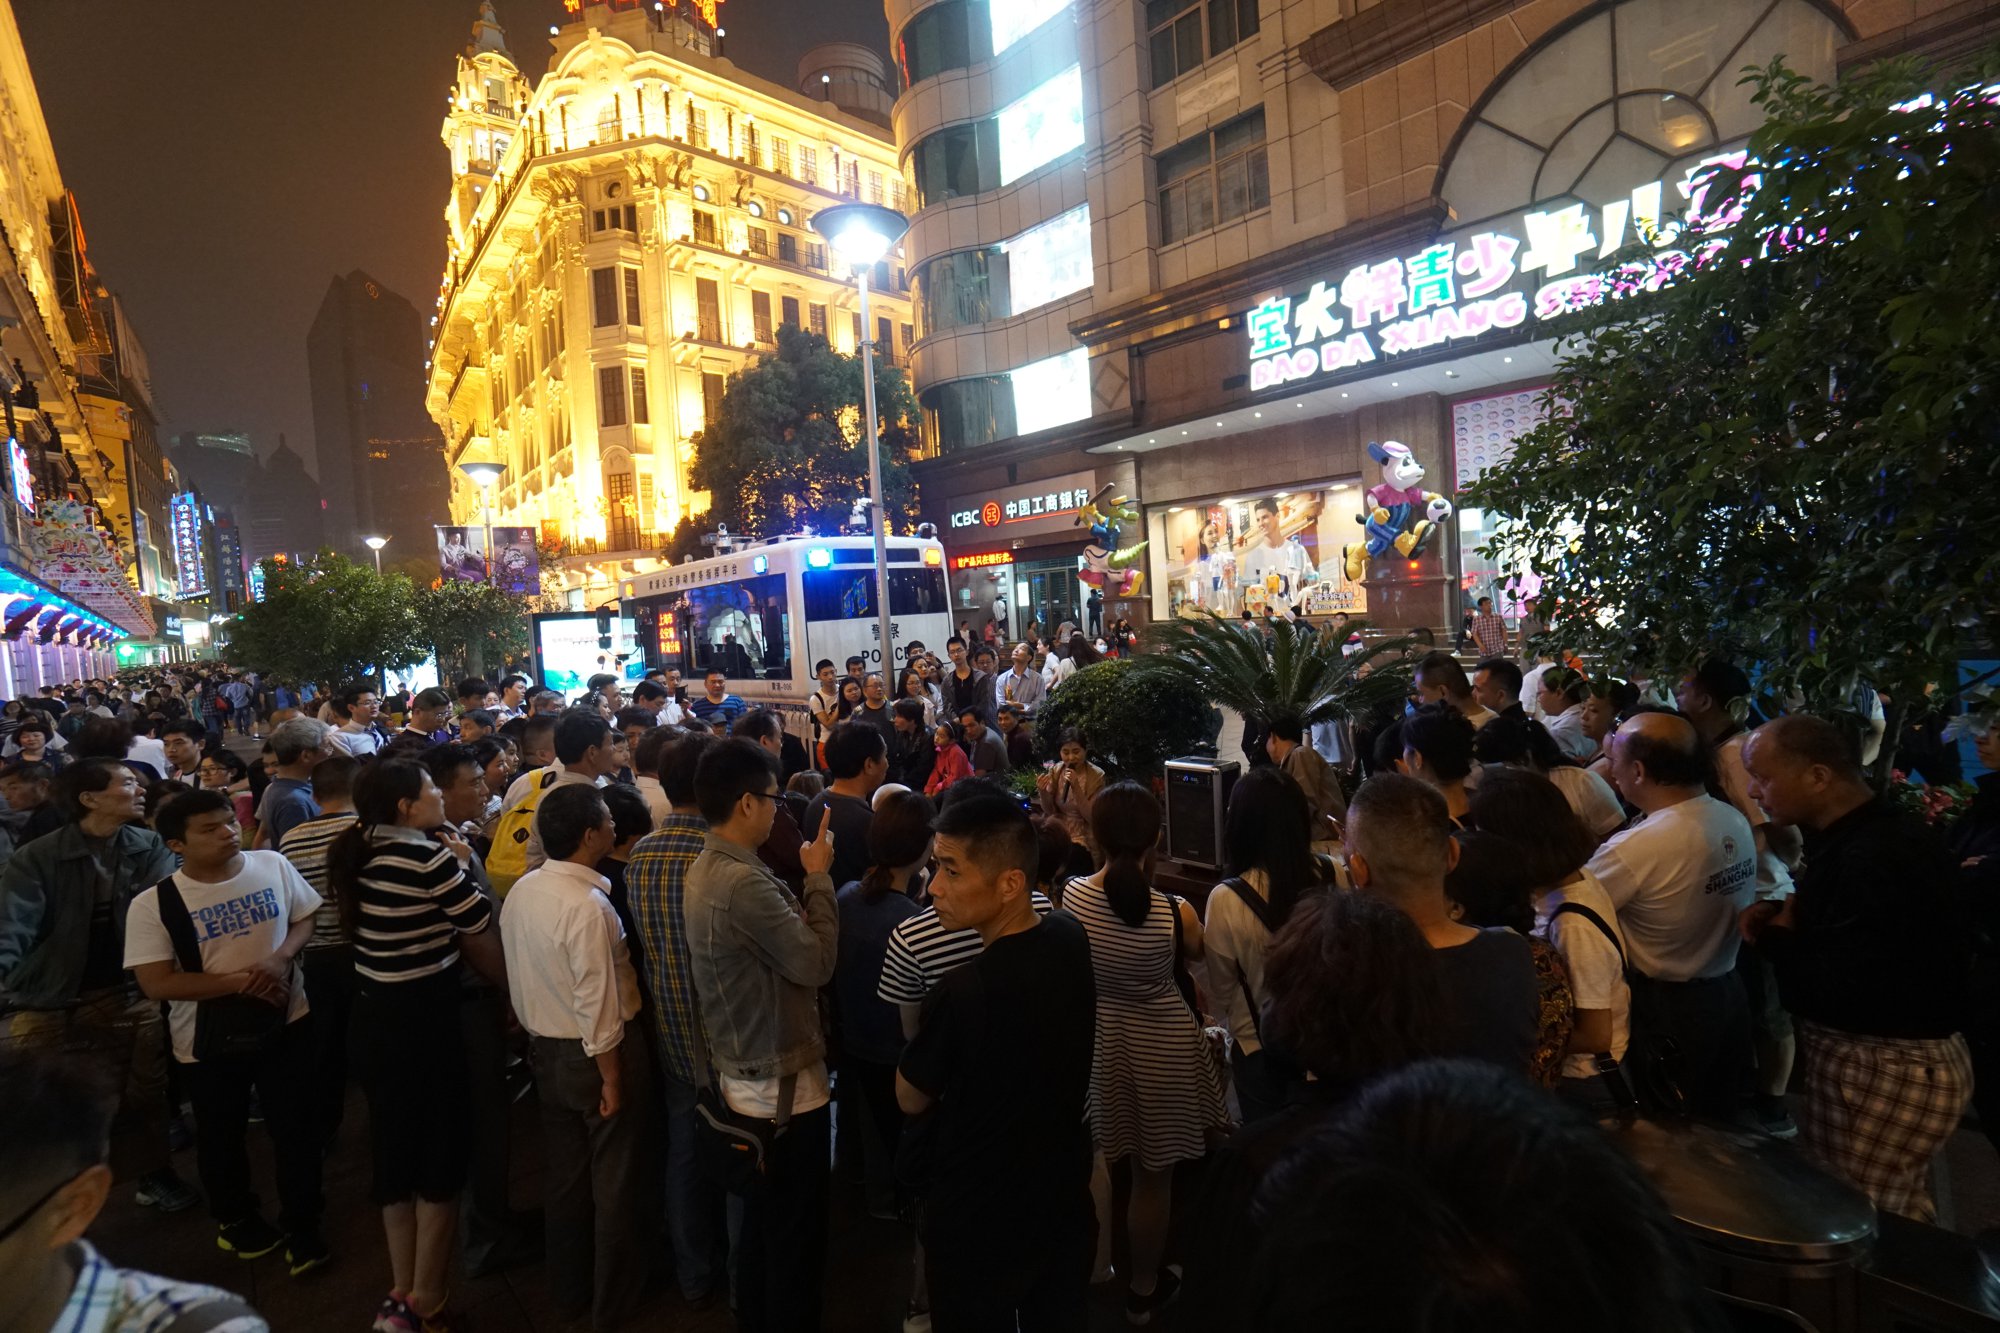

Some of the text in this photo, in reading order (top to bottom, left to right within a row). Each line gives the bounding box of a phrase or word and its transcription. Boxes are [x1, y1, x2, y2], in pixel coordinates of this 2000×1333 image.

[1250, 348, 1318, 391] BAO
[1322, 332, 1376, 372] DA
[1378, 292, 1527, 355] XIANG
[1005, 488, 1089, 518] 中国工商银行
[951, 509, 980, 528] ICBC
[658, 612, 673, 626] 上海市
[660, 627, 674, 640] 公安局
[1705, 864, 1755, 894] SHANGHAI
[189, 887, 276, 923] FOREVER
[194, 902, 280, 941] LEGEND
